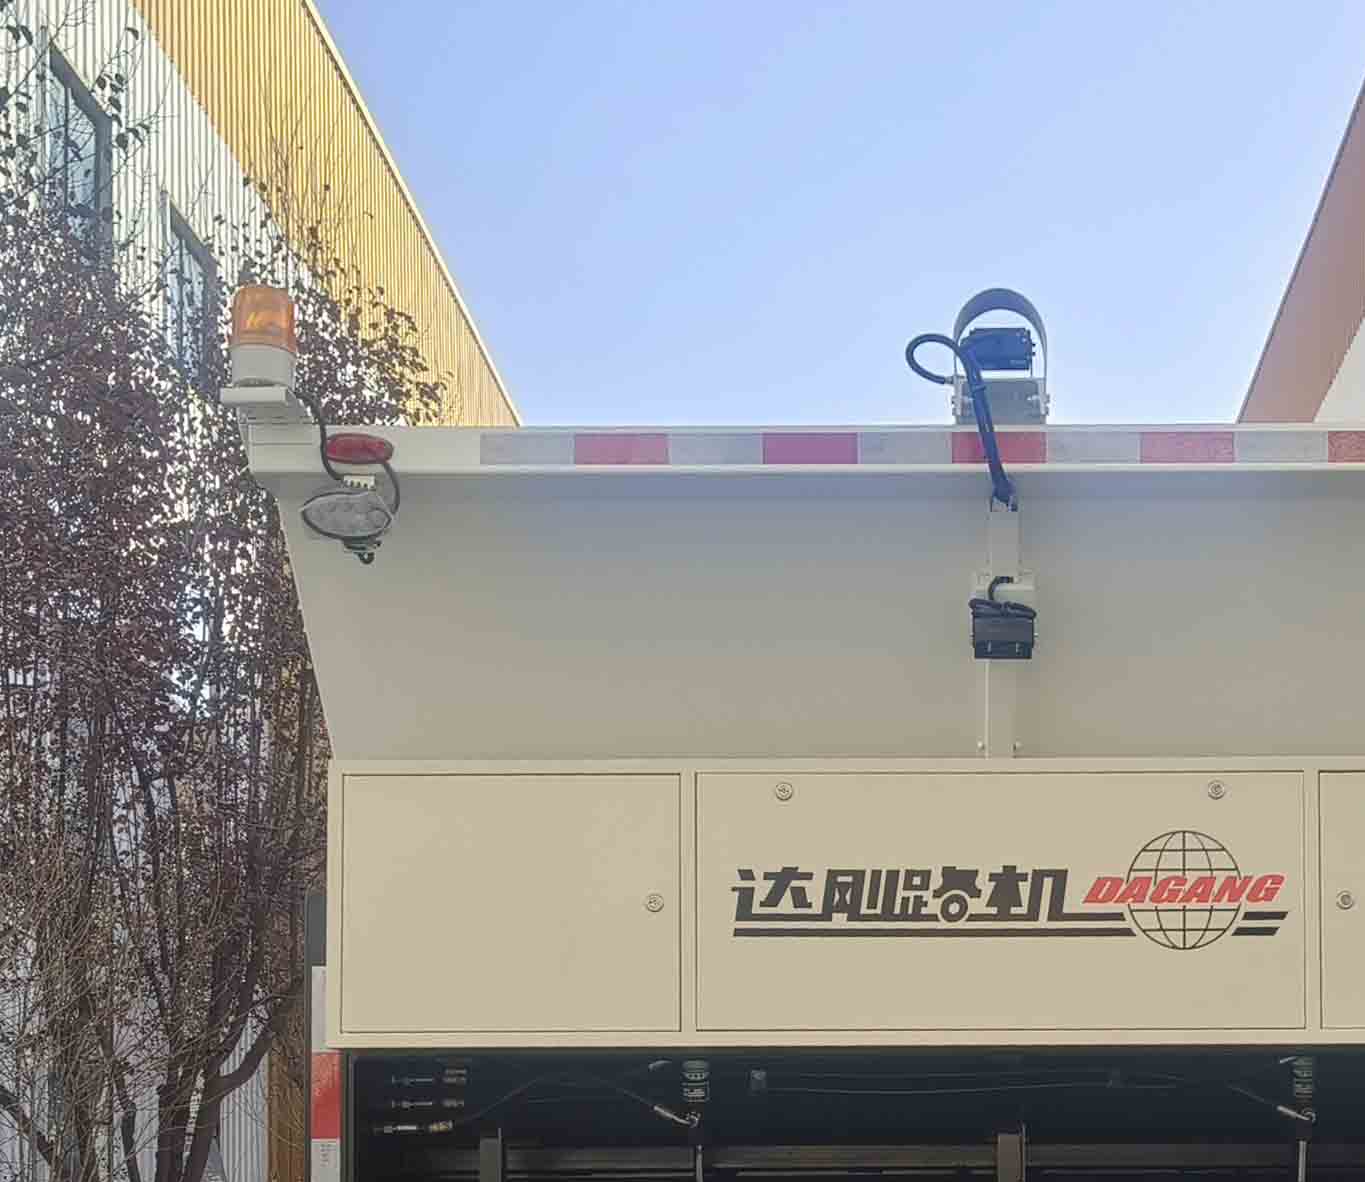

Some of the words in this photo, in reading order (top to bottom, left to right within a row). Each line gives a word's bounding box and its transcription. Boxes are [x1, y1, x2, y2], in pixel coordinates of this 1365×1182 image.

[731, 865, 1069, 922] 达刚路机
[1082, 873, 1286, 904] DAGANG
